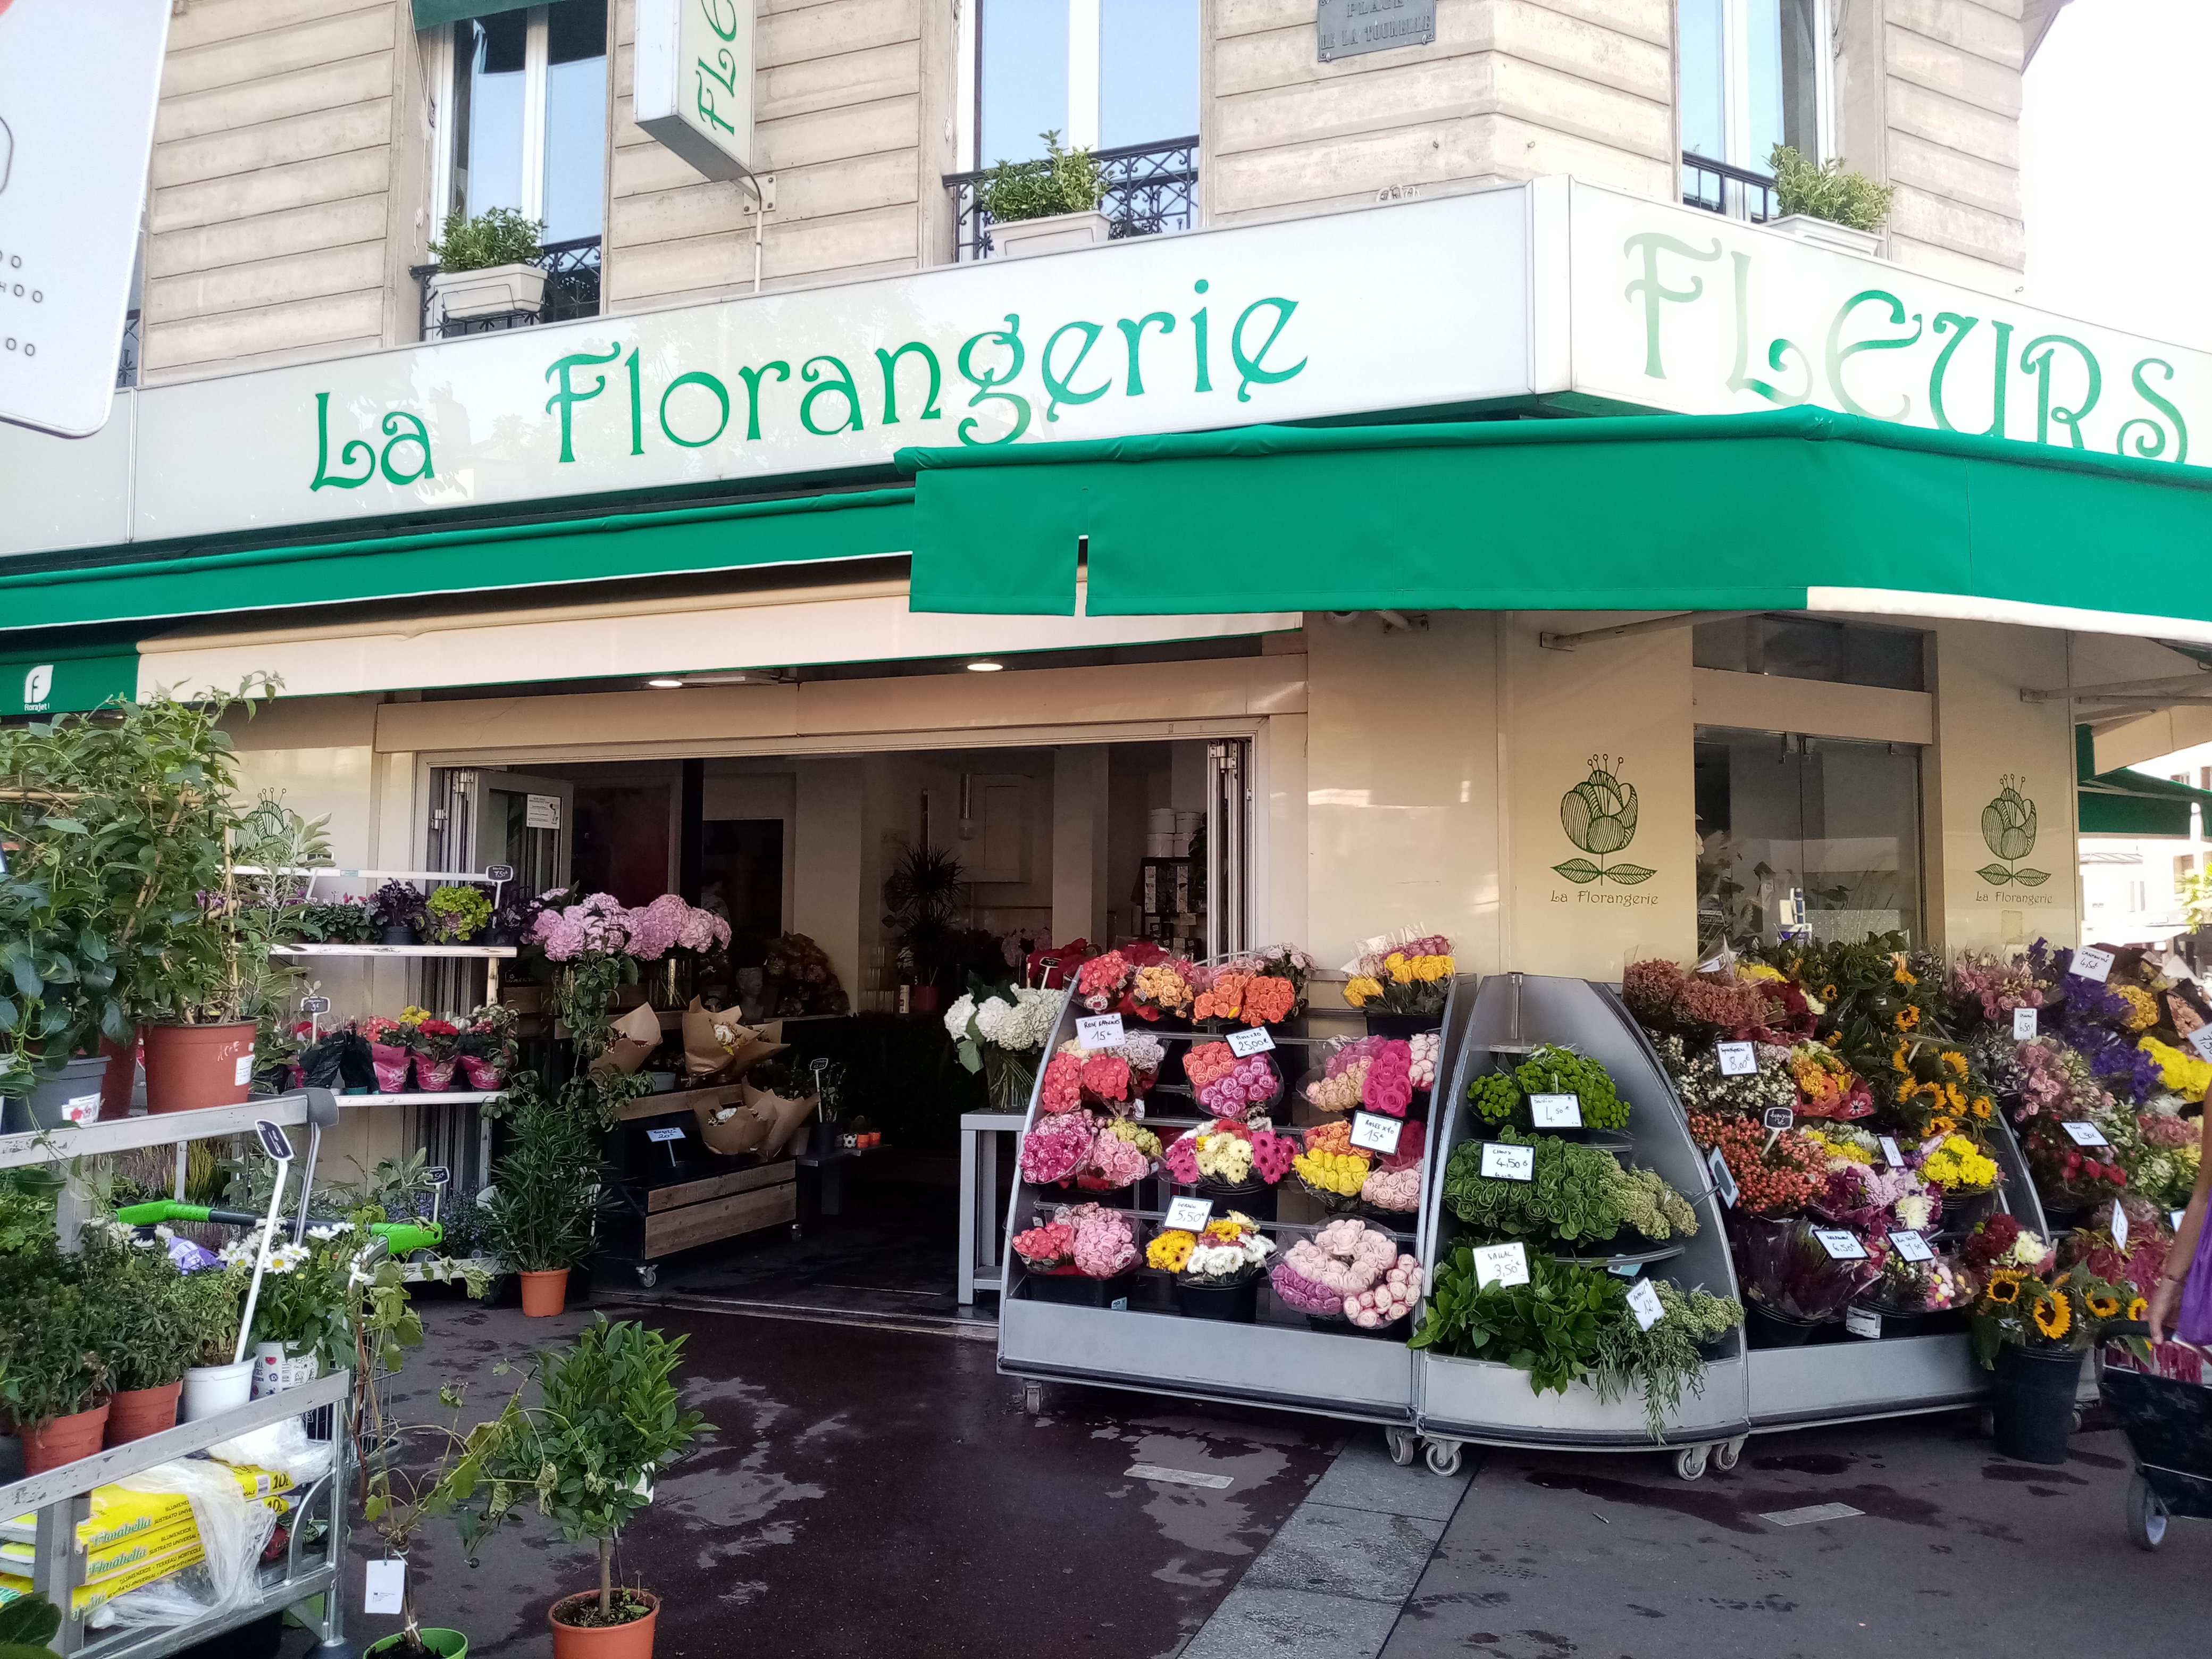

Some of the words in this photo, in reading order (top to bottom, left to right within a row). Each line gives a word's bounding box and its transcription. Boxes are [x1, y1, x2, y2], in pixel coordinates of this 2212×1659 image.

[310, 391, 434, 492] La
[546, 279, 1309, 463] Florangerie
[1623, 232, 2188, 463] FLEURS
[1551, 890, 1568, 902] La
[1577, 890, 1658, 907] Florangerie
[1976, 891, 1988, 901] La
[1996, 891, 2052, 906] Florangerie
